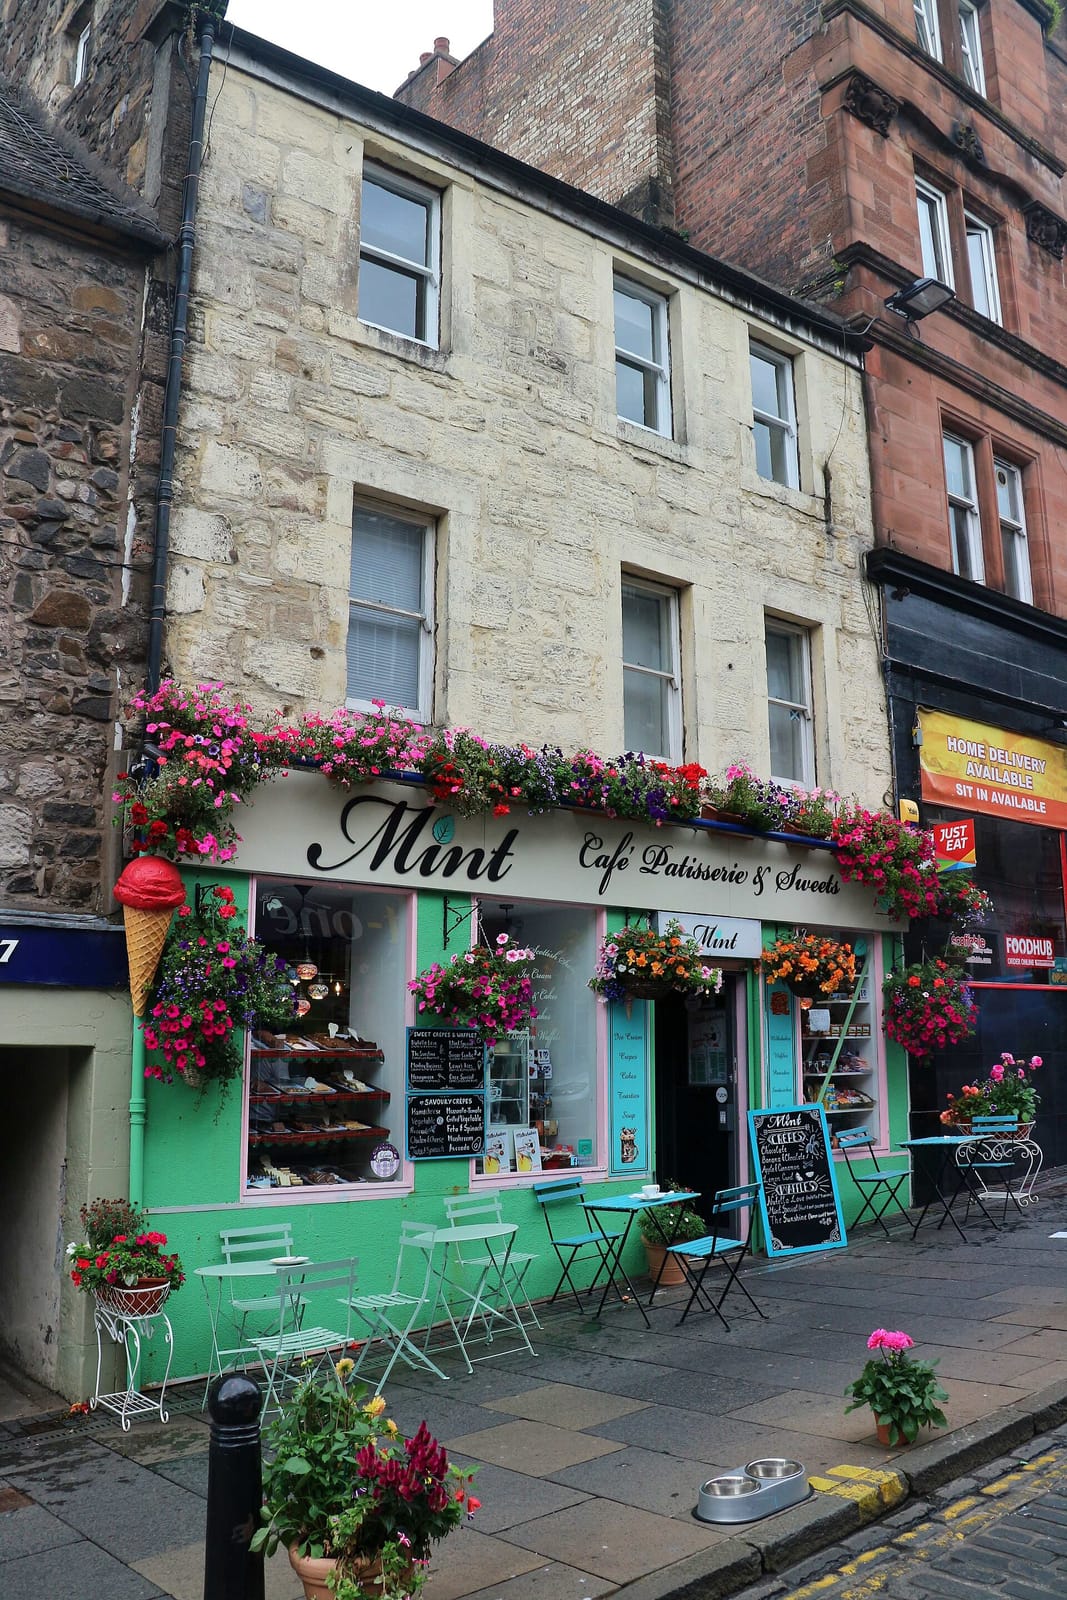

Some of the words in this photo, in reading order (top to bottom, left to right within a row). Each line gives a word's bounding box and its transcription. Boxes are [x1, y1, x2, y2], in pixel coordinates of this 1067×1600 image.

[947, 736, 986, 759] HOME
[989, 746, 1047, 774] DELIVERY
[966, 761, 1034, 790] AVAILABLE
[955, 783, 973, 798] SIT
[976, 789, 988, 801] IN
[991, 791, 1047, 814] AVAILABLE
[307, 795, 519, 882] Mint
[939, 825, 968, 842] JUST
[946, 837, 969, 851] EAT
[639, 844, 748, 885] Patisserie
[752, 866, 771, 896] &
[775, 863, 840, 895] Sweets
[692, 924, 739, 950] Mint
[1006, 937, 1053, 956] FOODHUB
[532, 968, 552, 980] Cream
[767, 1113, 802, 1128] Mint
[761, 1145, 787, 1155] Chocolate
